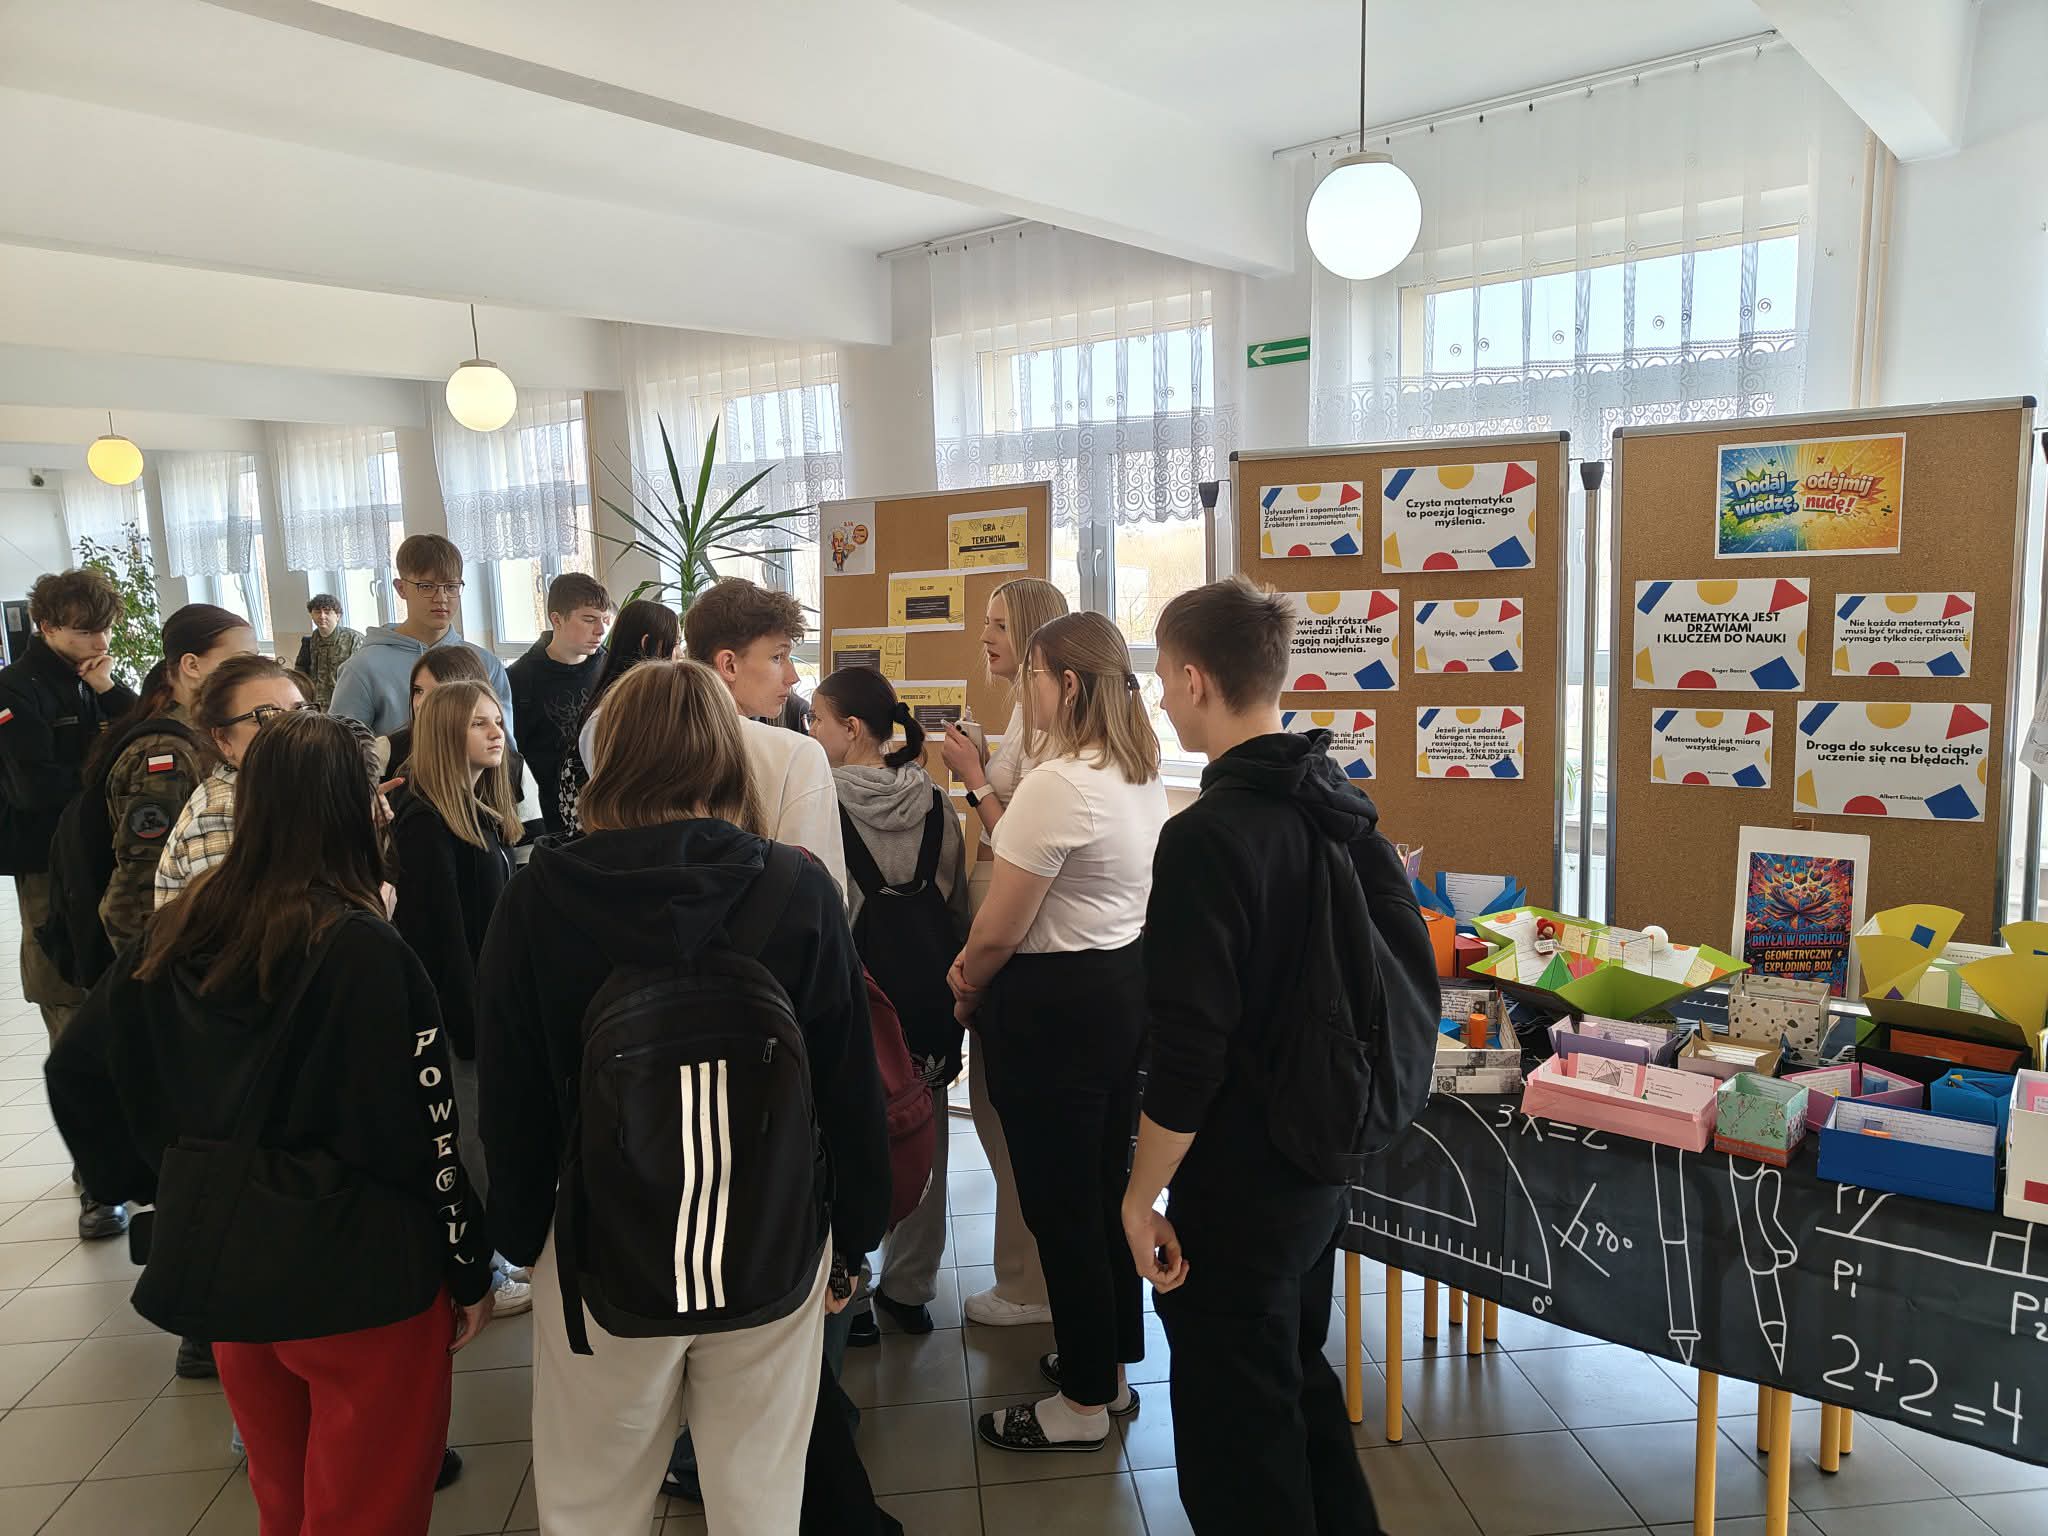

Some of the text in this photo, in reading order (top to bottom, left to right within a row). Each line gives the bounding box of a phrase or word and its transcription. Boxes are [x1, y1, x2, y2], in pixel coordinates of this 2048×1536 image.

[1736, 471, 1788, 499] Dodaj
[1806, 472, 1873, 496] odejmij
[1405, 495, 1513, 510] Czysta matematyka
[1804, 495, 1857, 516] nudę!
[1264, 508, 1305, 516] Usłyszałem
[1310, 505, 1361, 514] zapomniałem.
[1406, 506, 1515, 519] to poezja logicznego
[982, 523, 996, 532] GRA
[1434, 516, 1486, 528] myślenia.
[972, 534, 1006, 545] TERENOWA
[1297, 616, 1368, 627] wie najkrótsze
[1664, 612, 1780, 623] MATEMATYKA JEST
[1365, 625, 1382, 633] Nie
[1687, 623, 1752, 633] DRZWIAMI
[1849, 619, 1960, 628] Nie każda matematyka
[1434, 629, 1457, 638] Myślę,
[1460, 629, 1476, 637] więc
[1869, 626, 1885, 635] być
[1887, 627, 1923, 635] trudna,
[1292, 635, 1389, 646] agają najdłuższego
[1657, 634, 1786, 643] I KLUCZEM DO NAUKI
[1883, 634, 1907, 643] tylko
[1909, 634, 1969, 644] cierpliwości.
[1290, 645, 1366, 654] zastanowienia.
[1352, 731, 1365, 739] jest
[1665, 736, 1760, 747] Matematyka jest miarą
[1685, 744, 1739, 752] wszystkiego.
[1806, 740, 1983, 757] Droga do sukcesu to ciągłe
[1817, 753, 1969, 767] uczenie się na błędach.
[1752, 934, 1783, 947] BRYŁA
[1786, 934, 1796, 946] W
[1765, 950, 1833, 961] GEOMETRYCZNY
[1764, 961, 1833, 973] EXPLODING BOX
